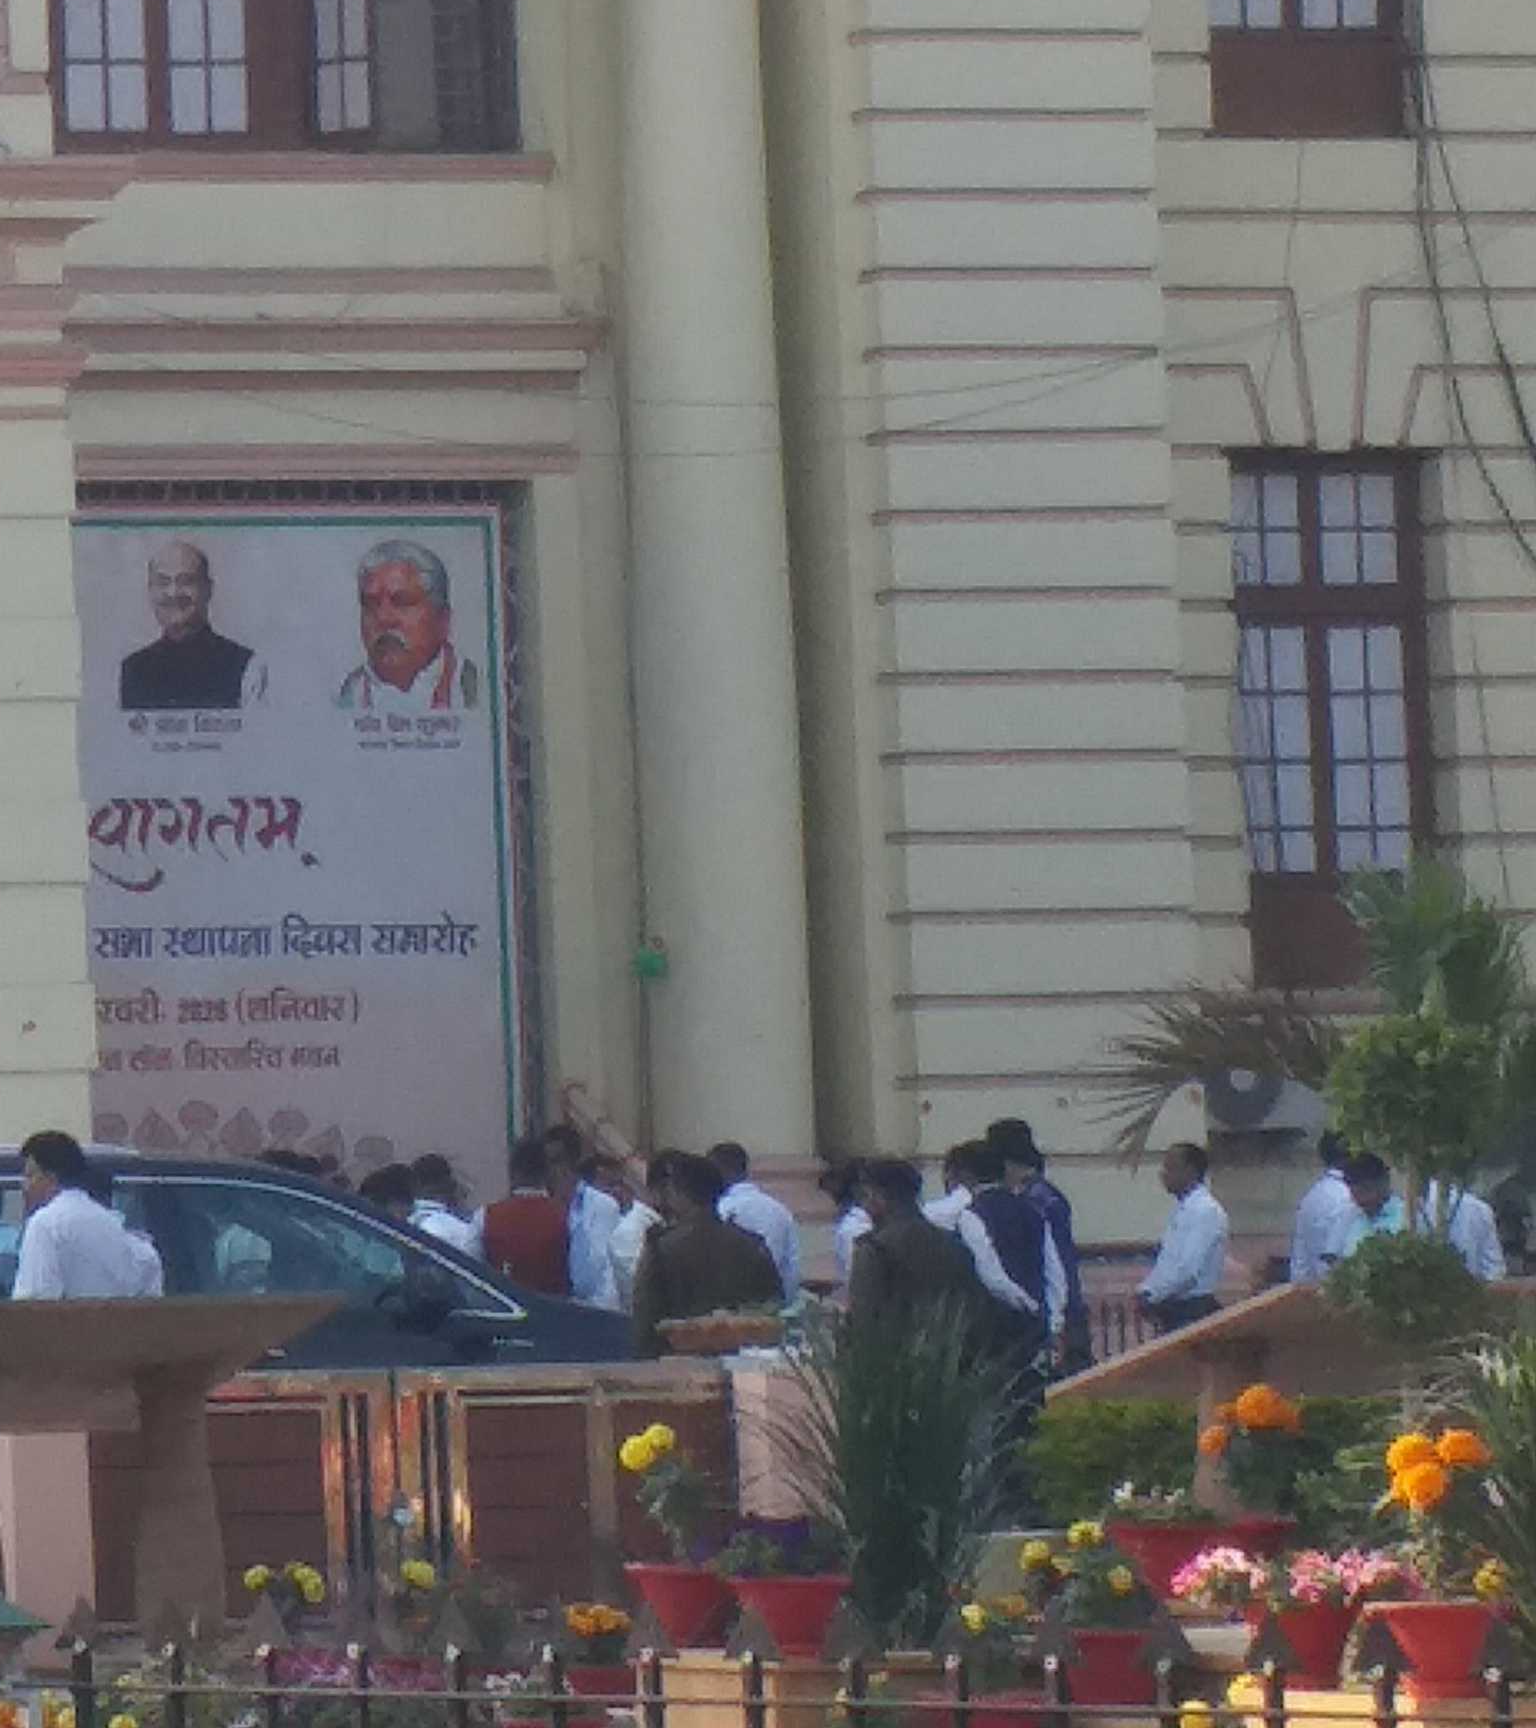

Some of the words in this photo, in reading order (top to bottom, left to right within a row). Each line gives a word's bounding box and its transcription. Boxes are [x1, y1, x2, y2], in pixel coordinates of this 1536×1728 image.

[163, 923, 273, 960] स्थापना
[281, 913, 362, 960] दिवस
[370, 909, 480, 958] समारोह
